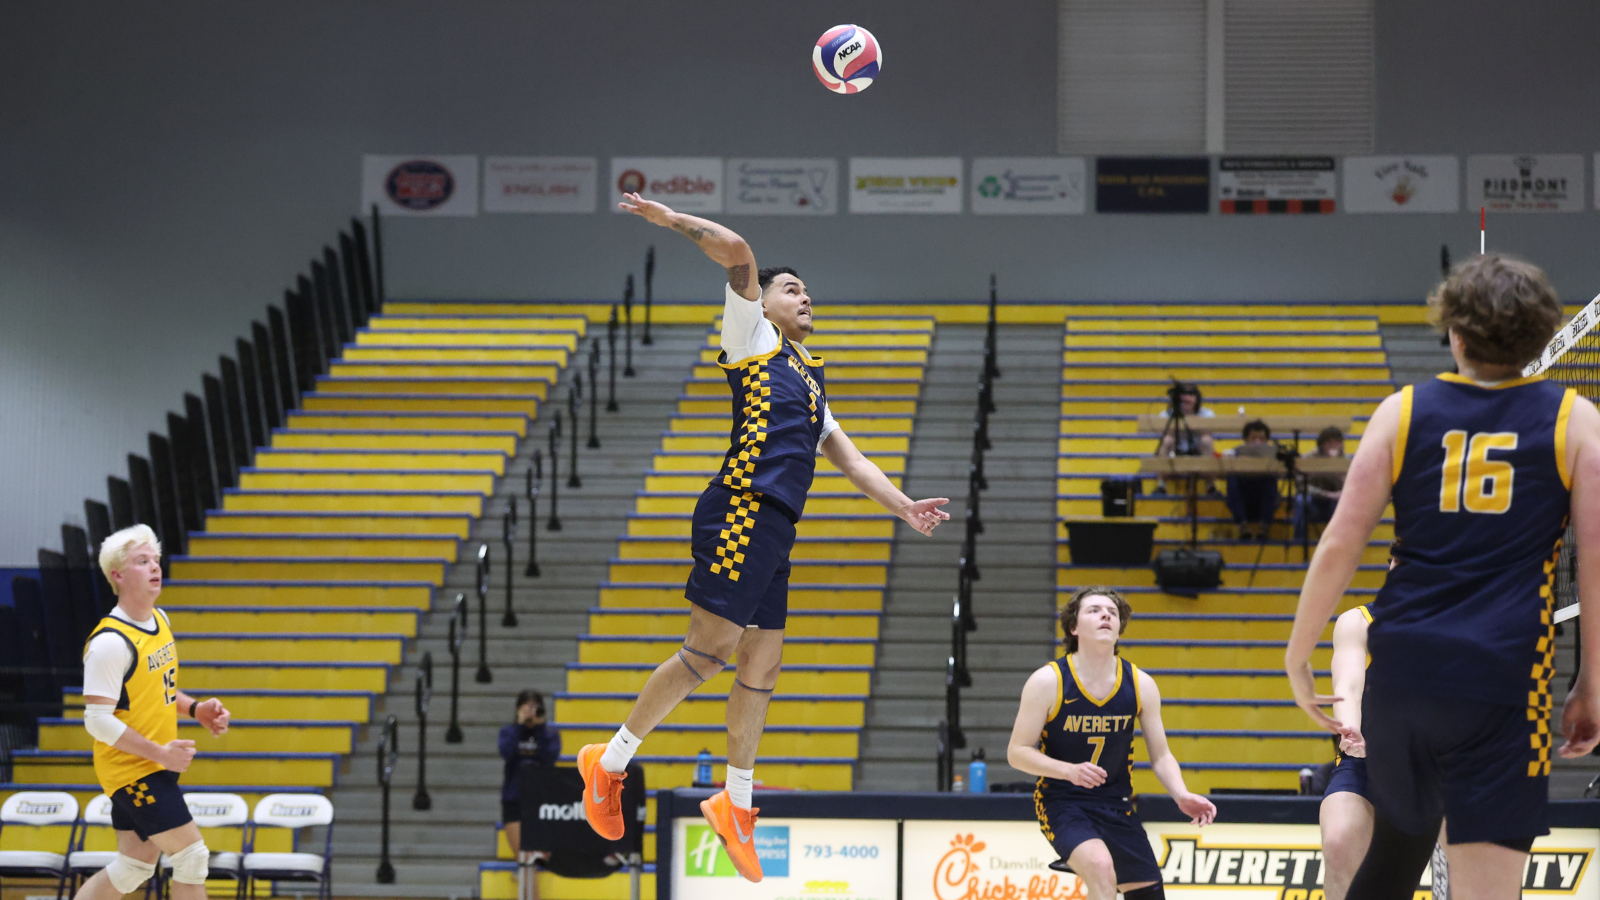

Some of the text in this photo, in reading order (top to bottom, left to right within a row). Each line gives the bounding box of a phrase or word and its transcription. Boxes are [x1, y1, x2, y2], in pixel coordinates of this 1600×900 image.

[838, 41, 862, 60] NCAA
[650, 174, 716, 195] edible
[1484, 178, 1567, 191] PIEDMONT
[1439, 429, 1518, 514] 16
[163, 666, 177, 706] 15
[1063, 714, 1132, 733] AVERETT
[1087, 736, 1106, 766] 7
[756, 848, 787, 860] press
[803, 845, 879, 859] 793-4000
